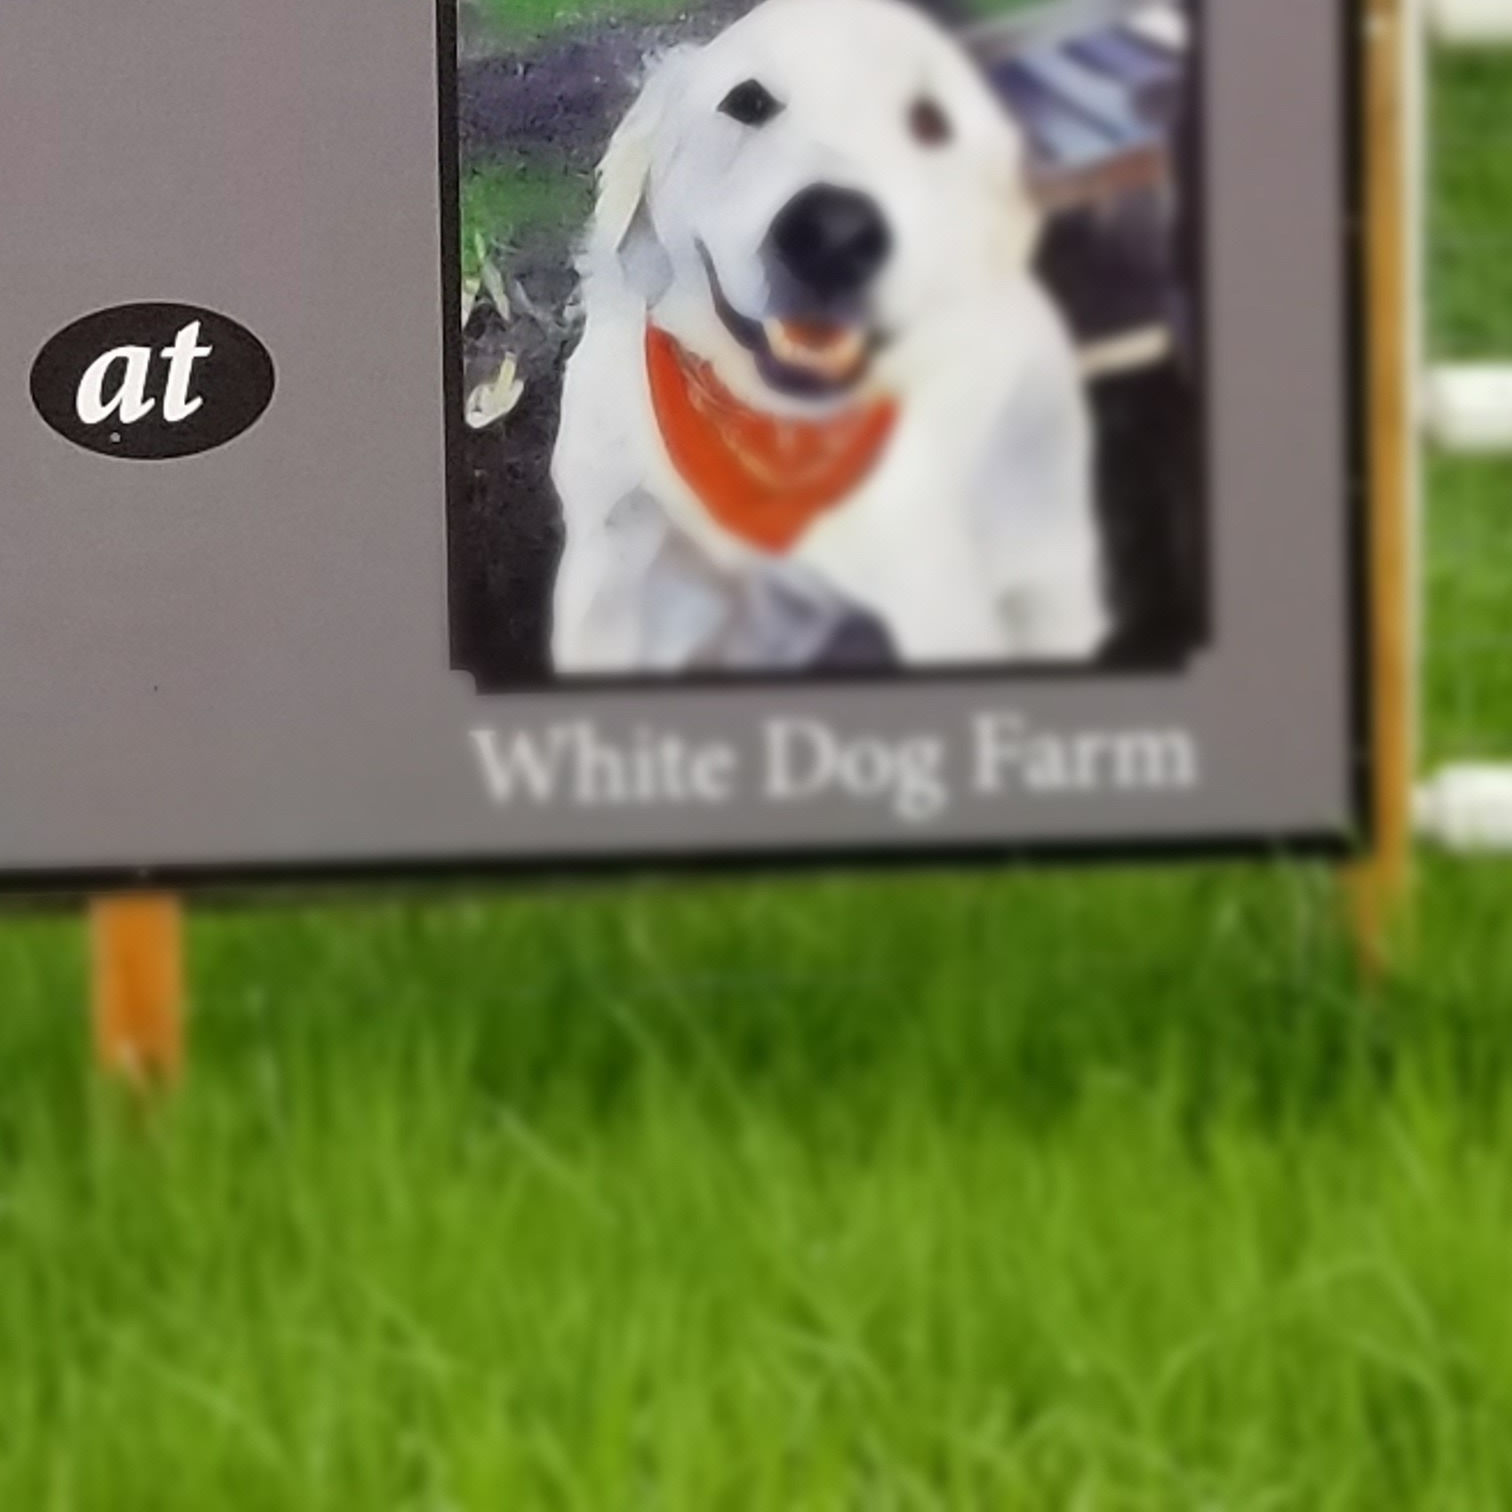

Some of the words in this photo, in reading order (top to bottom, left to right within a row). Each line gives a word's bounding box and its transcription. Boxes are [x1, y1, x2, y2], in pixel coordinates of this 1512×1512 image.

[76, 320, 213, 424] at
[469, 716, 737, 804] White
[762, 716, 948, 822] Dog
[972, 711, 1197, 792] Farm
